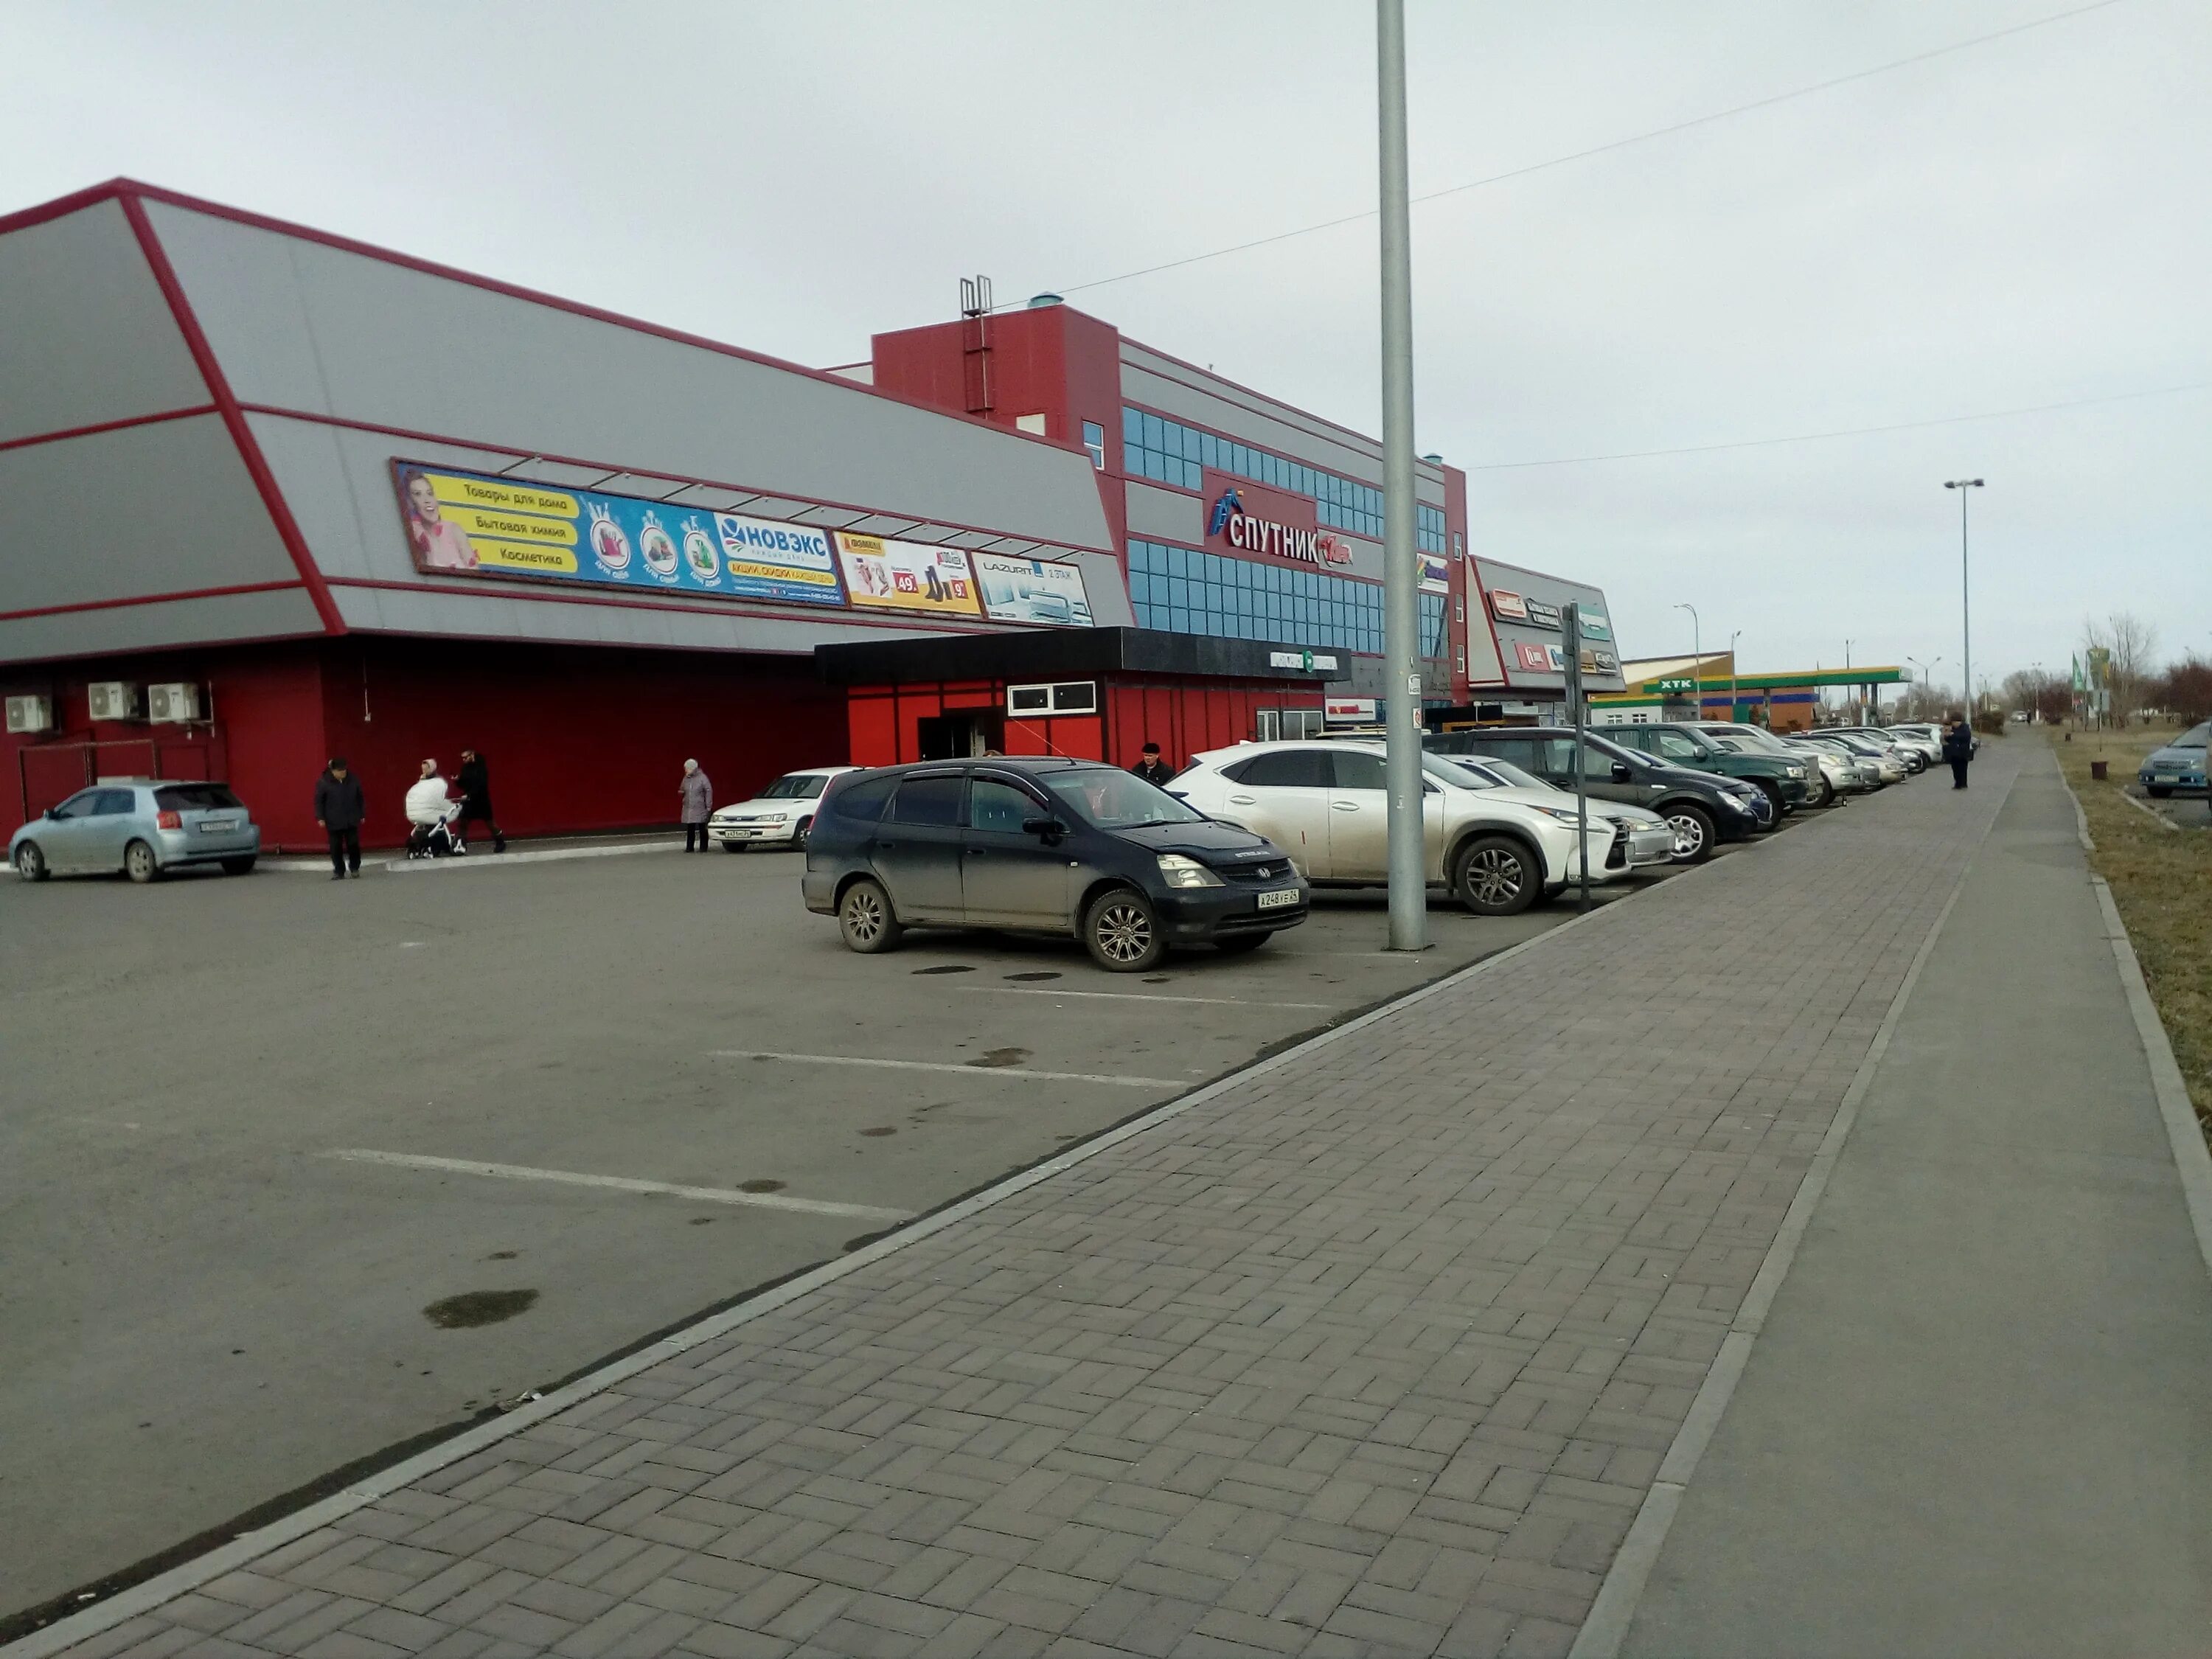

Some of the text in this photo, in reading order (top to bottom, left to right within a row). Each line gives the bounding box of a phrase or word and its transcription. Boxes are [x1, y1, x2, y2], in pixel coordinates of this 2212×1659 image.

[464, 484, 567, 510] Товары для дома
[476, 515, 566, 538] Бытовая химия
[1229, 513, 1319, 563] СПУТНИК
[745, 525, 827, 557] НОВЭКС
[499, 548, 563, 566] Косметика
[983, 562, 1033, 575] LAZURIT
[1660, 680, 1692, 689] ХТК
